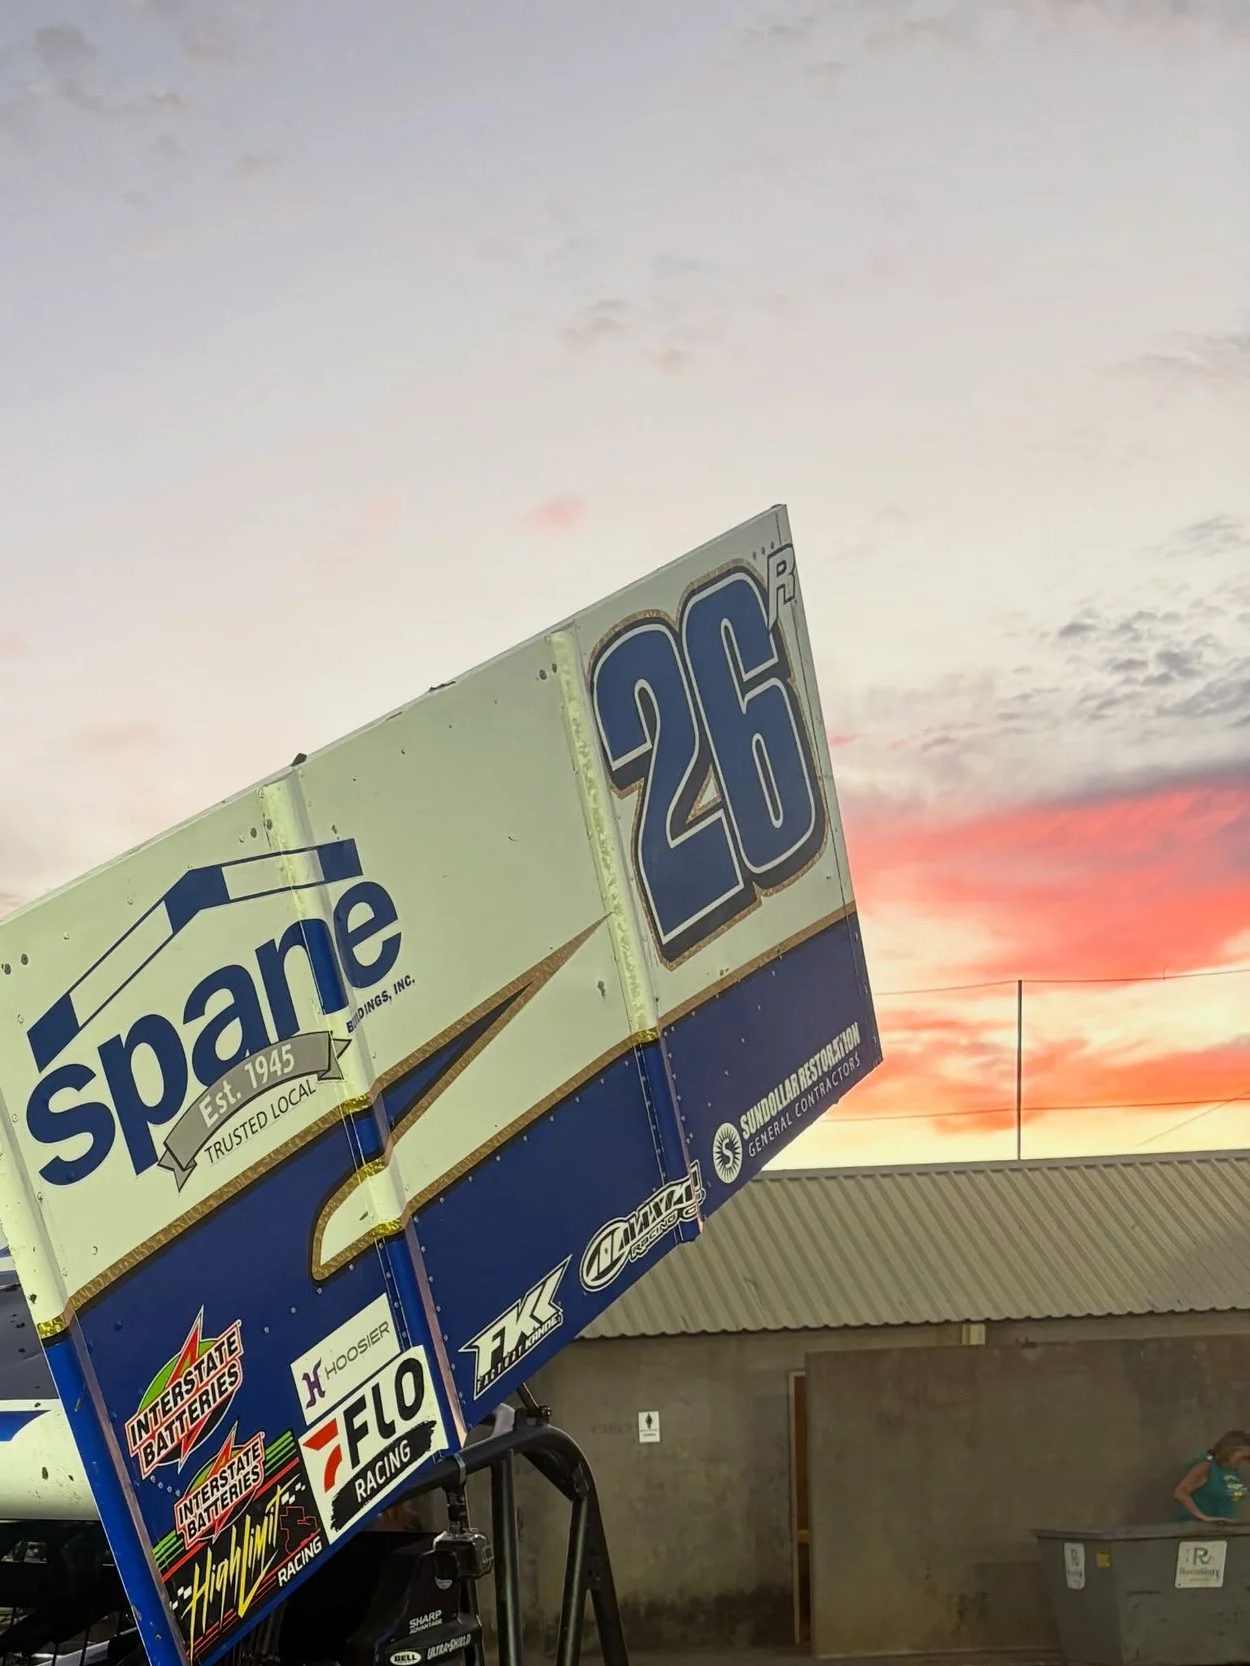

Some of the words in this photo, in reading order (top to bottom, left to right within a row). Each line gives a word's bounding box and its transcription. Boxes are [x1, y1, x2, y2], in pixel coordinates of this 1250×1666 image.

[591, 565, 824, 960] 26
[393, 975, 416, 995] INC.
[26, 881, 402, 1186] spane
[199, 1079, 242, 1128] Est.
[244, 1043, 296, 1091] 1945
[204, 1111, 268, 1164] TRUSTED
[269, 1080, 316, 1119] LOCAL
[740, 1073, 799, 1140] SUNDOLLAR
[797, 1022, 861, 1090] RESTORATION
[748, 1113, 792, 1157] GENERAL
[795, 1052, 861, 1117] CONTRACTORS
[130, 1332, 238, 1447] INTERSTATE
[325, 1321, 390, 1380] HOOSIER
[144, 1362, 238, 1469] BATTERIES
[179, 1441, 261, 1524] INTERSTATE
[187, 1465, 260, 1539] BATTERIES
[354, 1440, 411, 1503] RACING
[278, 1536, 322, 1587] RACING
[409, 1609, 443, 1628] SHARP
